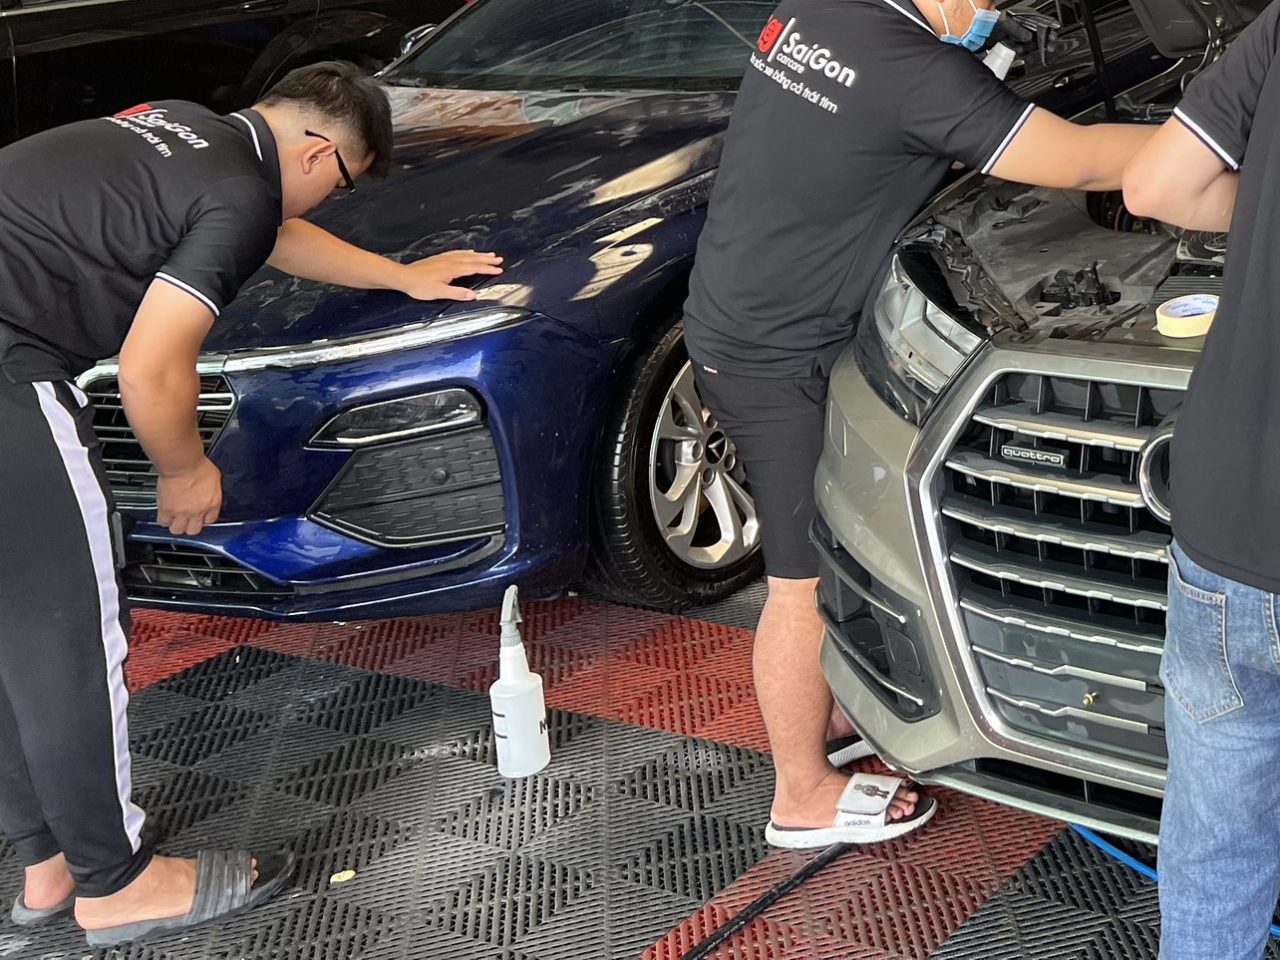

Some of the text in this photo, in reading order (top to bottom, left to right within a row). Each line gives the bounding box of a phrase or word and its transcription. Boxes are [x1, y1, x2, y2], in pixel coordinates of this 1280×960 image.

[776, 52, 805, 74] carcare
[782, 32, 856, 87] SaiGon
[819, 96, 838, 113] tim
[138, 113, 209, 149] SaiGon
[1004, 448, 1060, 463] quattro
